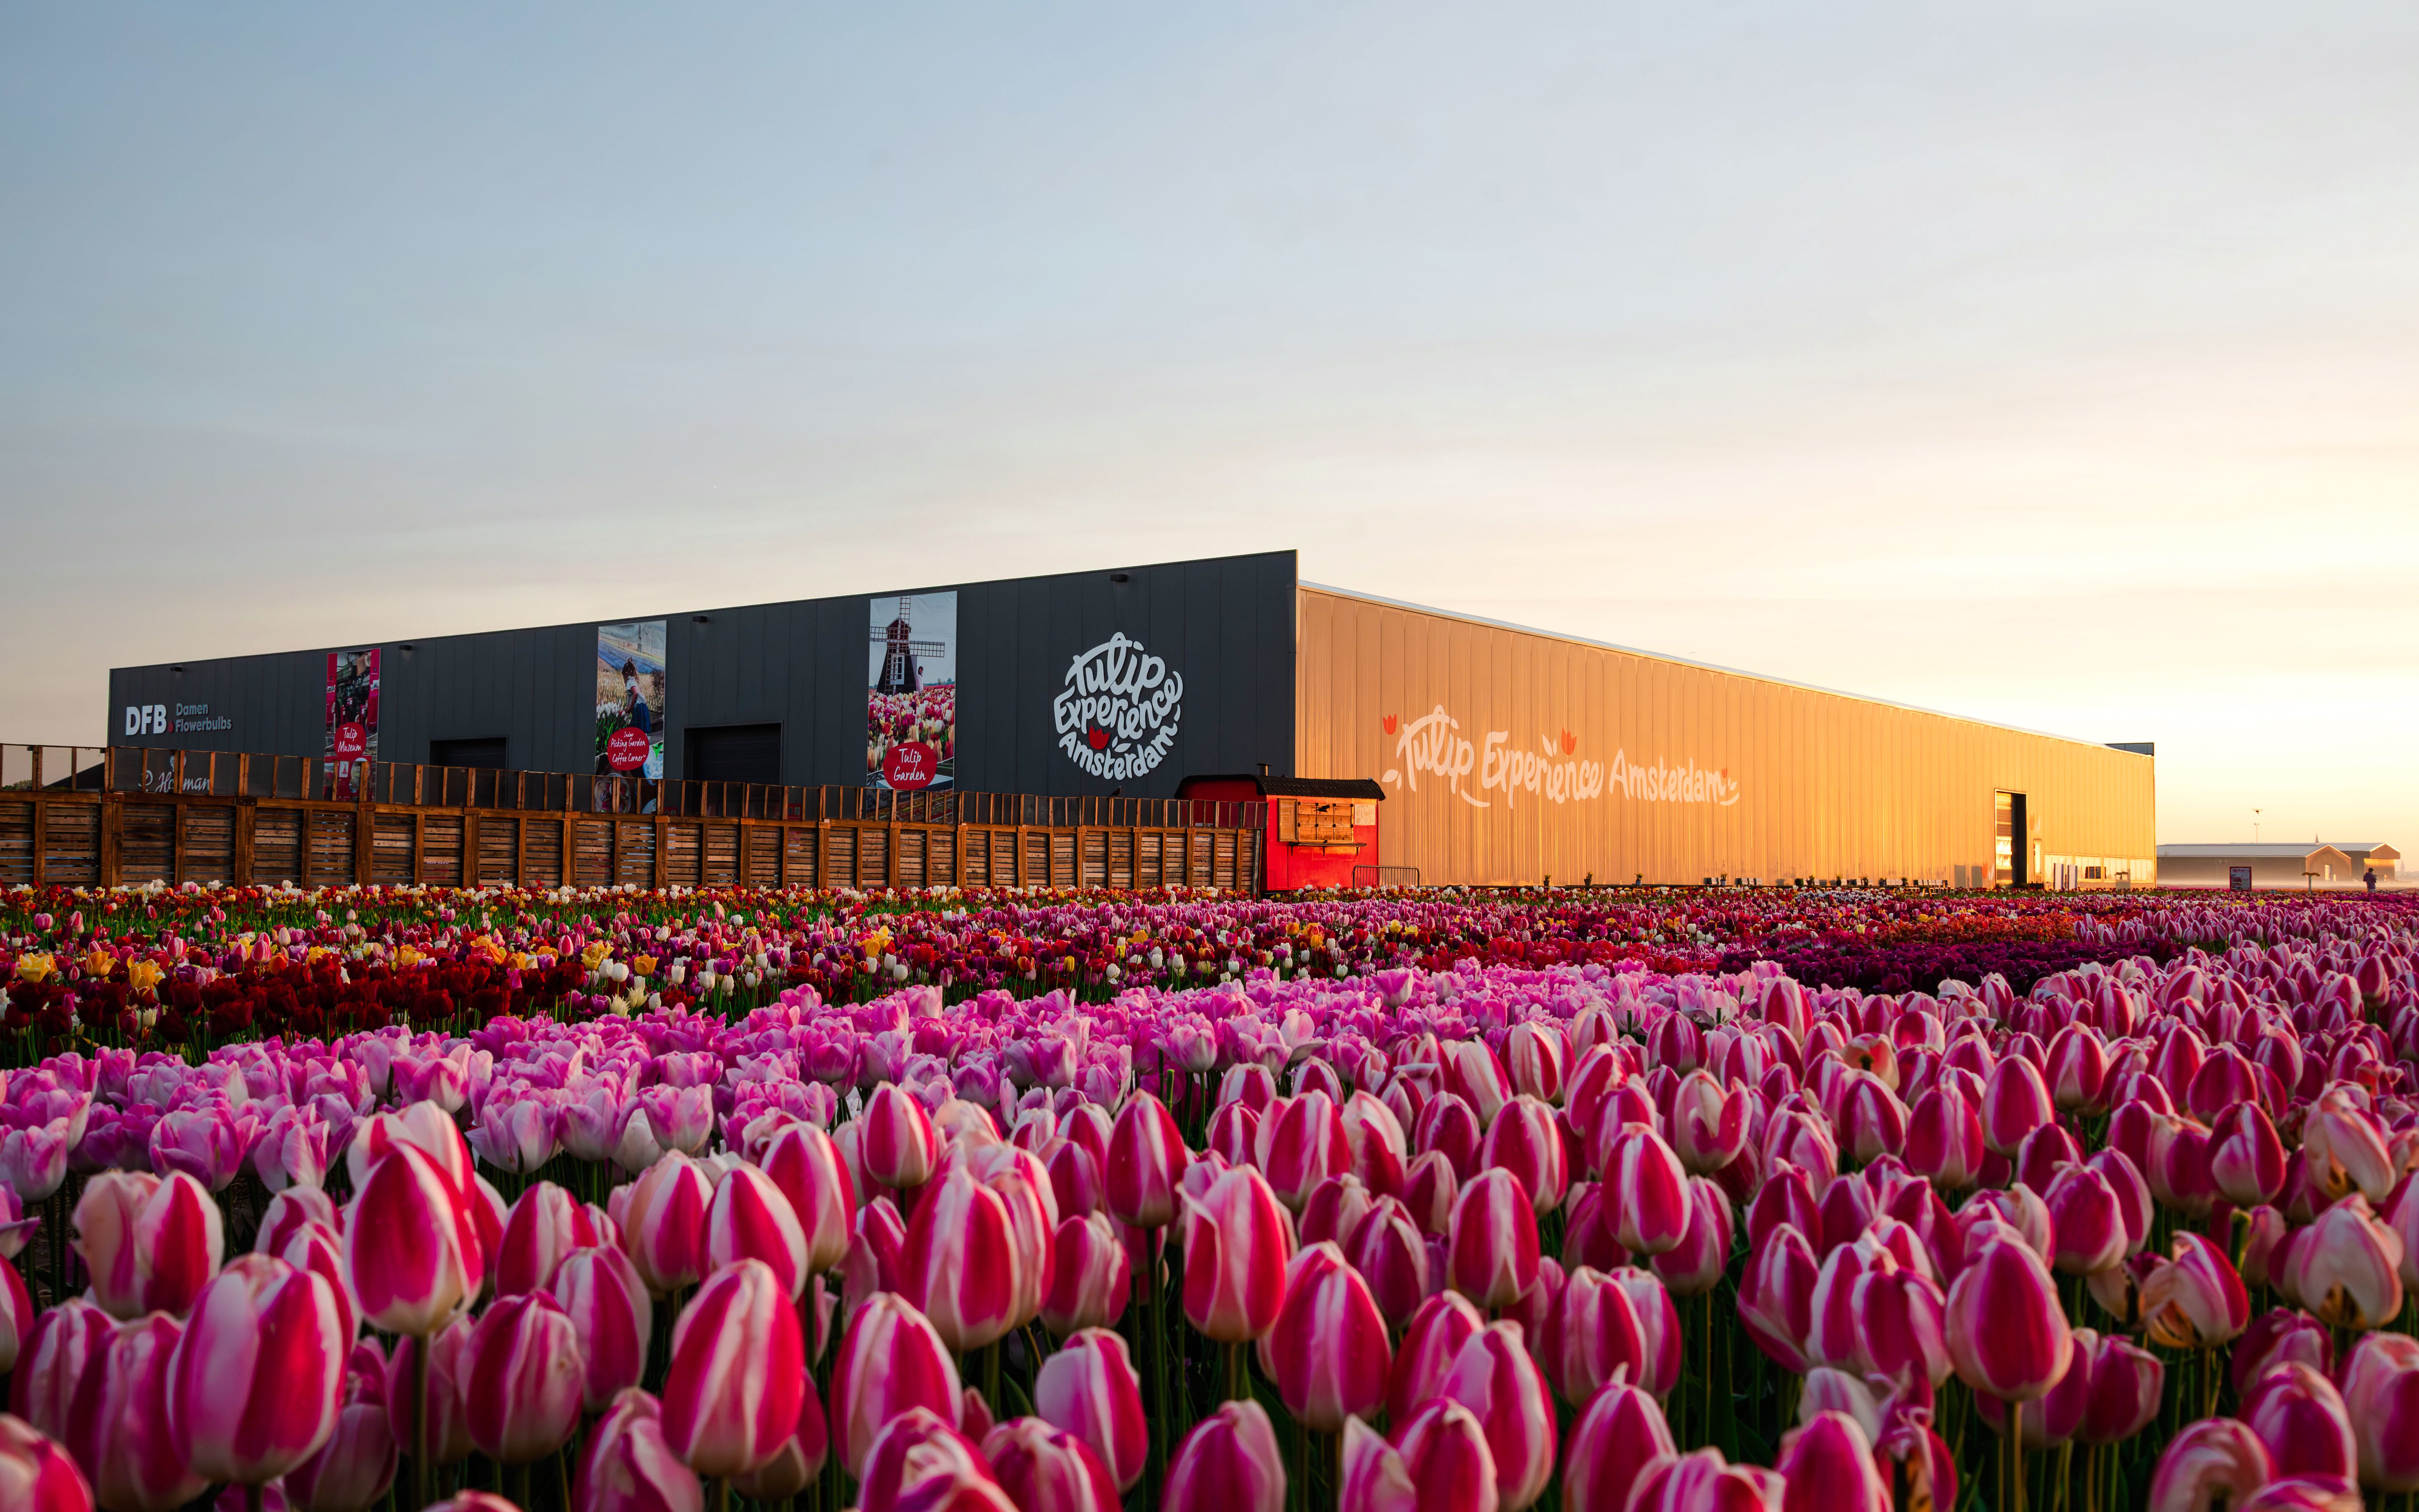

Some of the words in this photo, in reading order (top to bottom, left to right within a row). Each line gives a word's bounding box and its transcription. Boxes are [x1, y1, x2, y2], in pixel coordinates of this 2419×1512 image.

[1065, 632, 1166, 705] Tulip
[176, 703, 208, 716] Damen
[1054, 671, 1183, 740] Experience
[126, 705, 166, 735] DFB
[176, 717, 232, 732] Flowerbulbs
[343, 727, 357, 741] Tulip
[338, 741, 361, 752] Museum
[611, 738, 627, 752] Picking
[628, 738, 646, 746] Garden
[1059, 723, 1178, 781] Amsterdam
[612, 752, 627, 765] Coffee
[899, 748, 922, 767] Tulip
[1396, 704, 1474, 794] Tulip
[1482, 730, 1604, 809] Experience
[1609, 748, 1729, 804] Amsterdam
[894, 767, 926, 781] Garden
